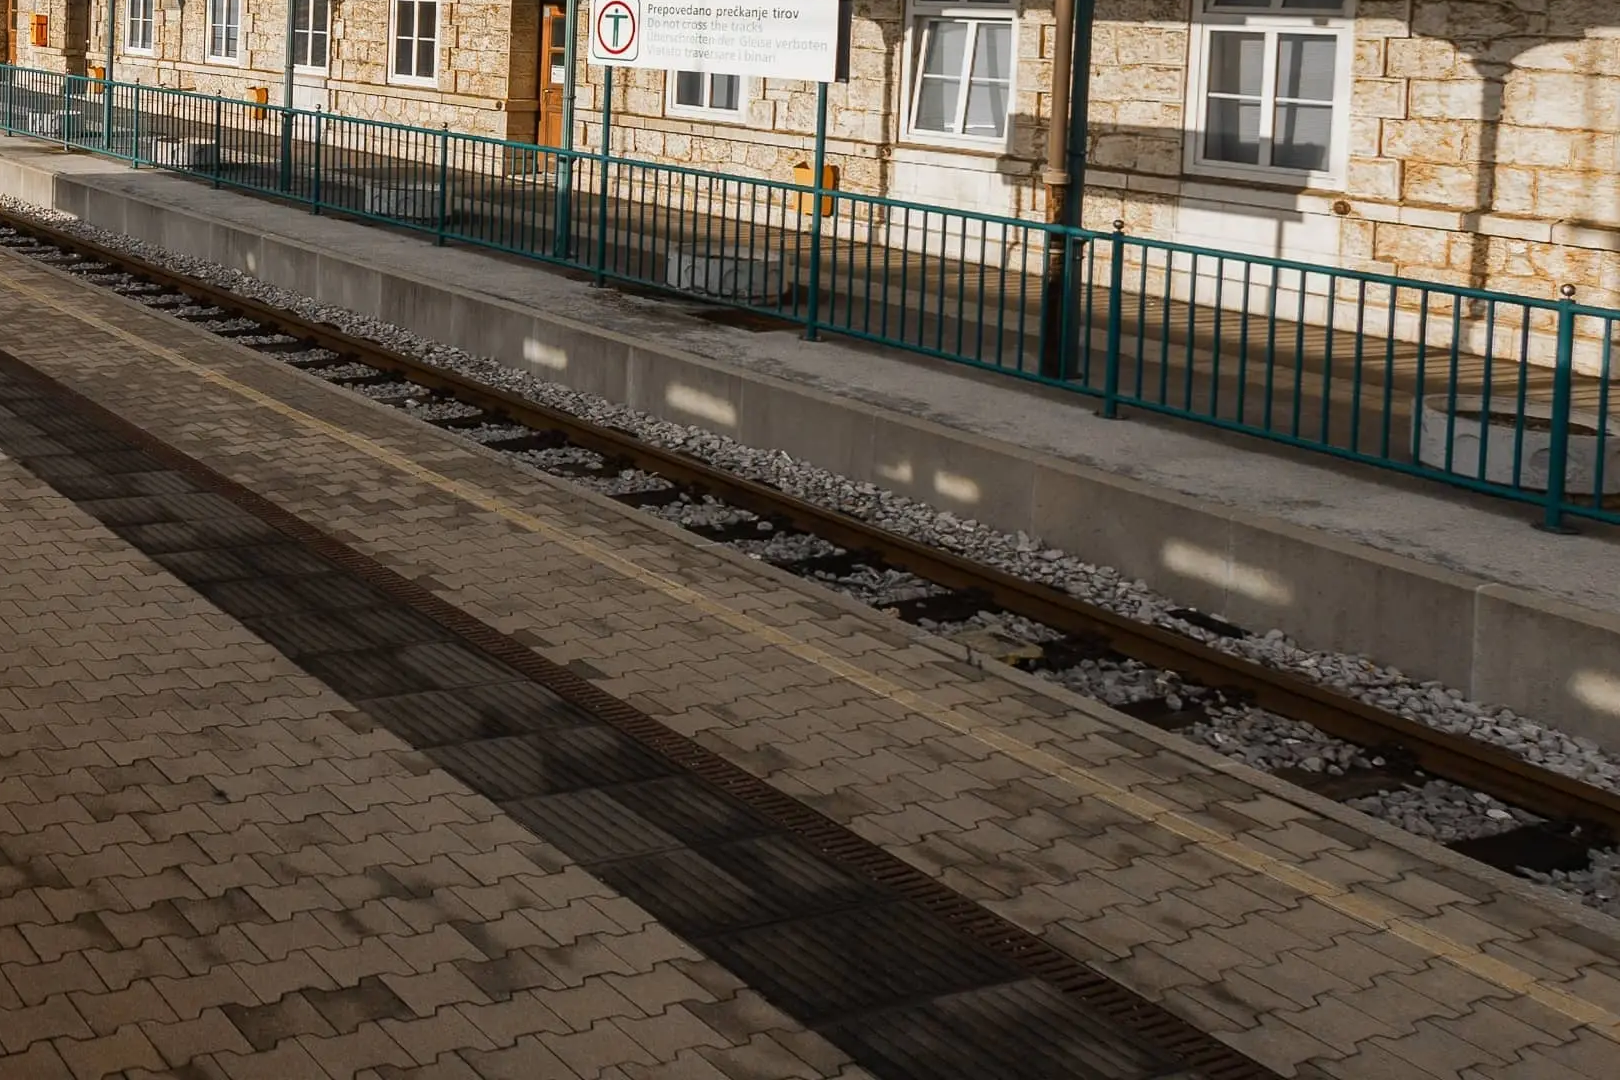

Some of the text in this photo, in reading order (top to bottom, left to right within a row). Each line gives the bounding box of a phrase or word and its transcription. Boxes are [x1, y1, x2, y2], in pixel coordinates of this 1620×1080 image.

[647, 3, 800, 21] Prepovedano prečkanje tirov
[647, 17, 763, 33] Do not cross the tracks
[717, 35, 735, 46] der
[739, 36, 772, 48] Gleise
